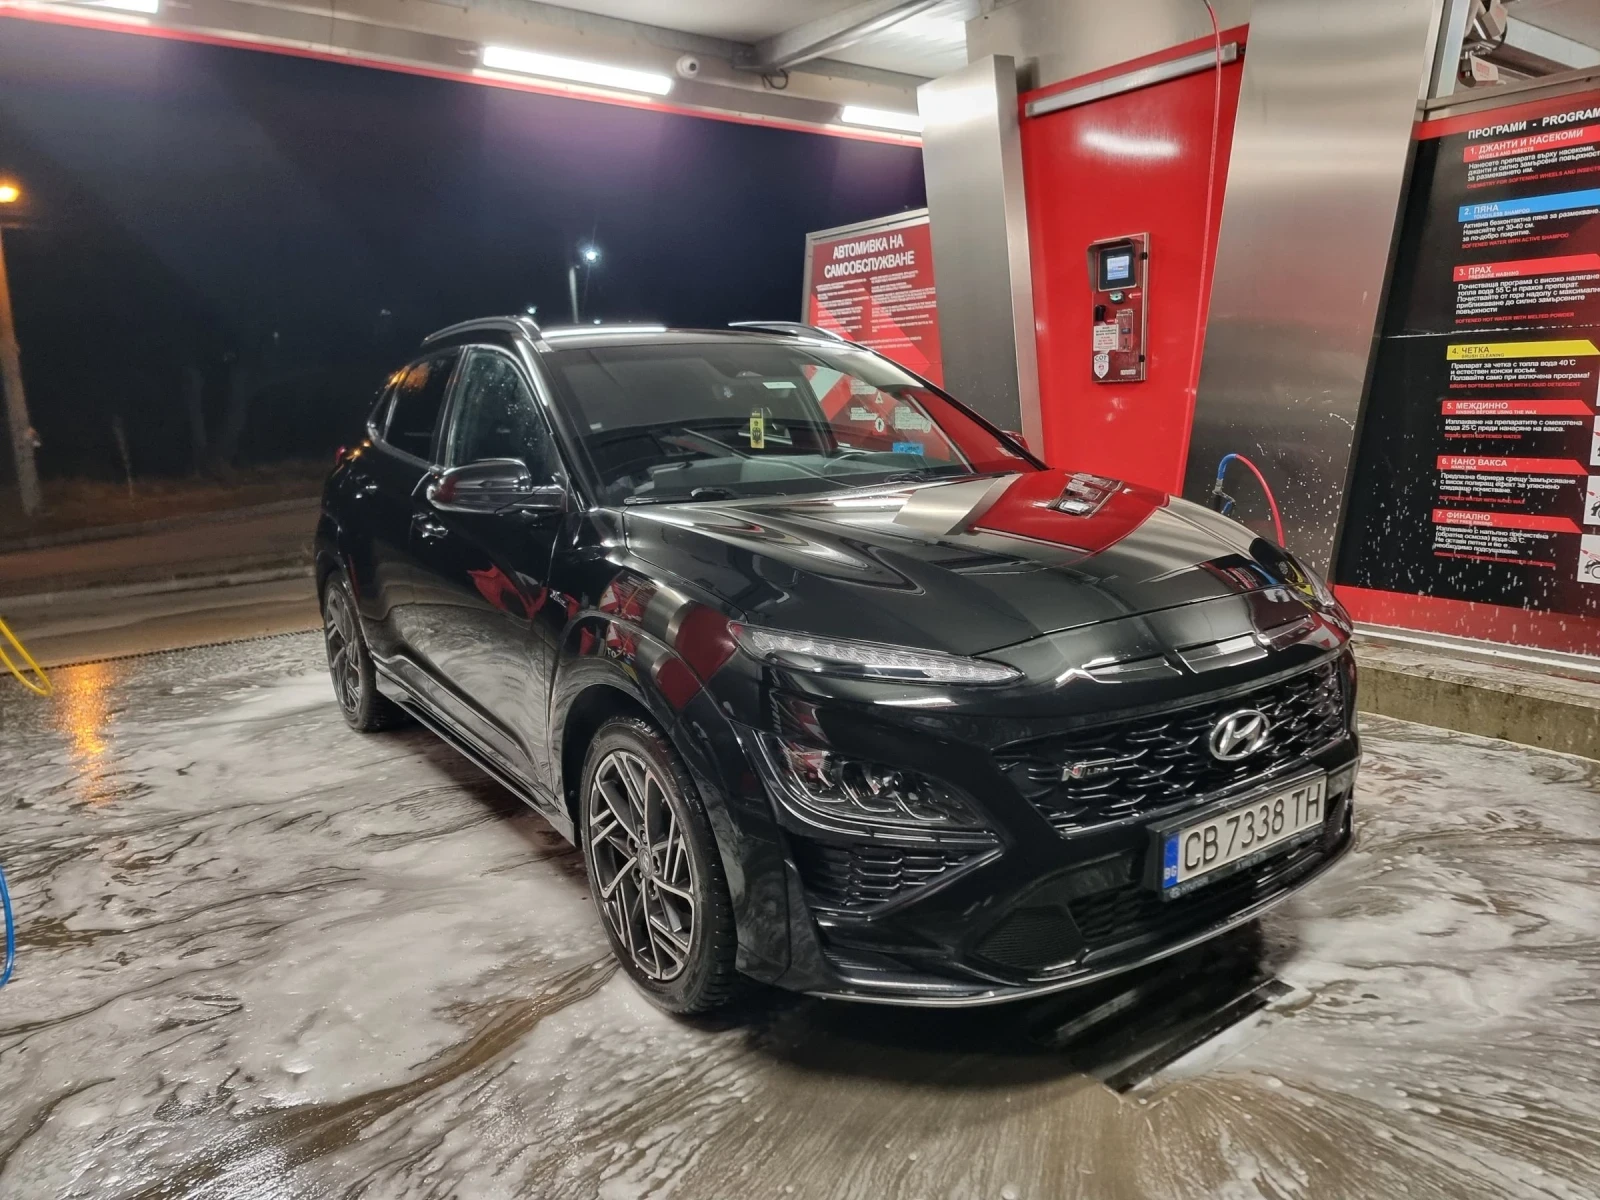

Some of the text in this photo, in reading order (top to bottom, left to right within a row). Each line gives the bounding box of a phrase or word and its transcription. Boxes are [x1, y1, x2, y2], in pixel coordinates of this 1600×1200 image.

[1468, 121, 1527, 139] ПРОГРАМИ
[1470, 129, 1584, 155] 1. ДЖАНТИ И НАСЕКОМИ
[1500, 154, 1535, 165] препарата
[1537, 151, 1557, 160] върху
[1499, 163, 1519, 171] силно
[1464, 204, 1498, 216] 2. ПЯНА
[1464, 221, 1488, 229] Активна
[1490, 216, 1531, 226] безконтактна
[1505, 223, 1523, 231] 30-40
[833, 234, 904, 260] АВТОМИВКА НА
[824, 250, 914, 278] САМООБСЛУЖВАНЕ
[1459, 266, 1492, 276] 3. ПРАХ
[1500, 279, 1532, 287] програма
[1462, 346, 1490, 354] ЧЕТКА
[1451, 362, 1482, 370] Препарат
[1553, 372, 1590, 380] програма!
[1446, 402, 1508, 410] 5. МЕЖДИННО
[1451, 458, 1476, 466] НАНО
[1446, 512, 1490, 520] ФИНАЛНО
[1184, 783, 1322, 871] CB 7338 TH
[1164, 866, 1177, 880] BG
